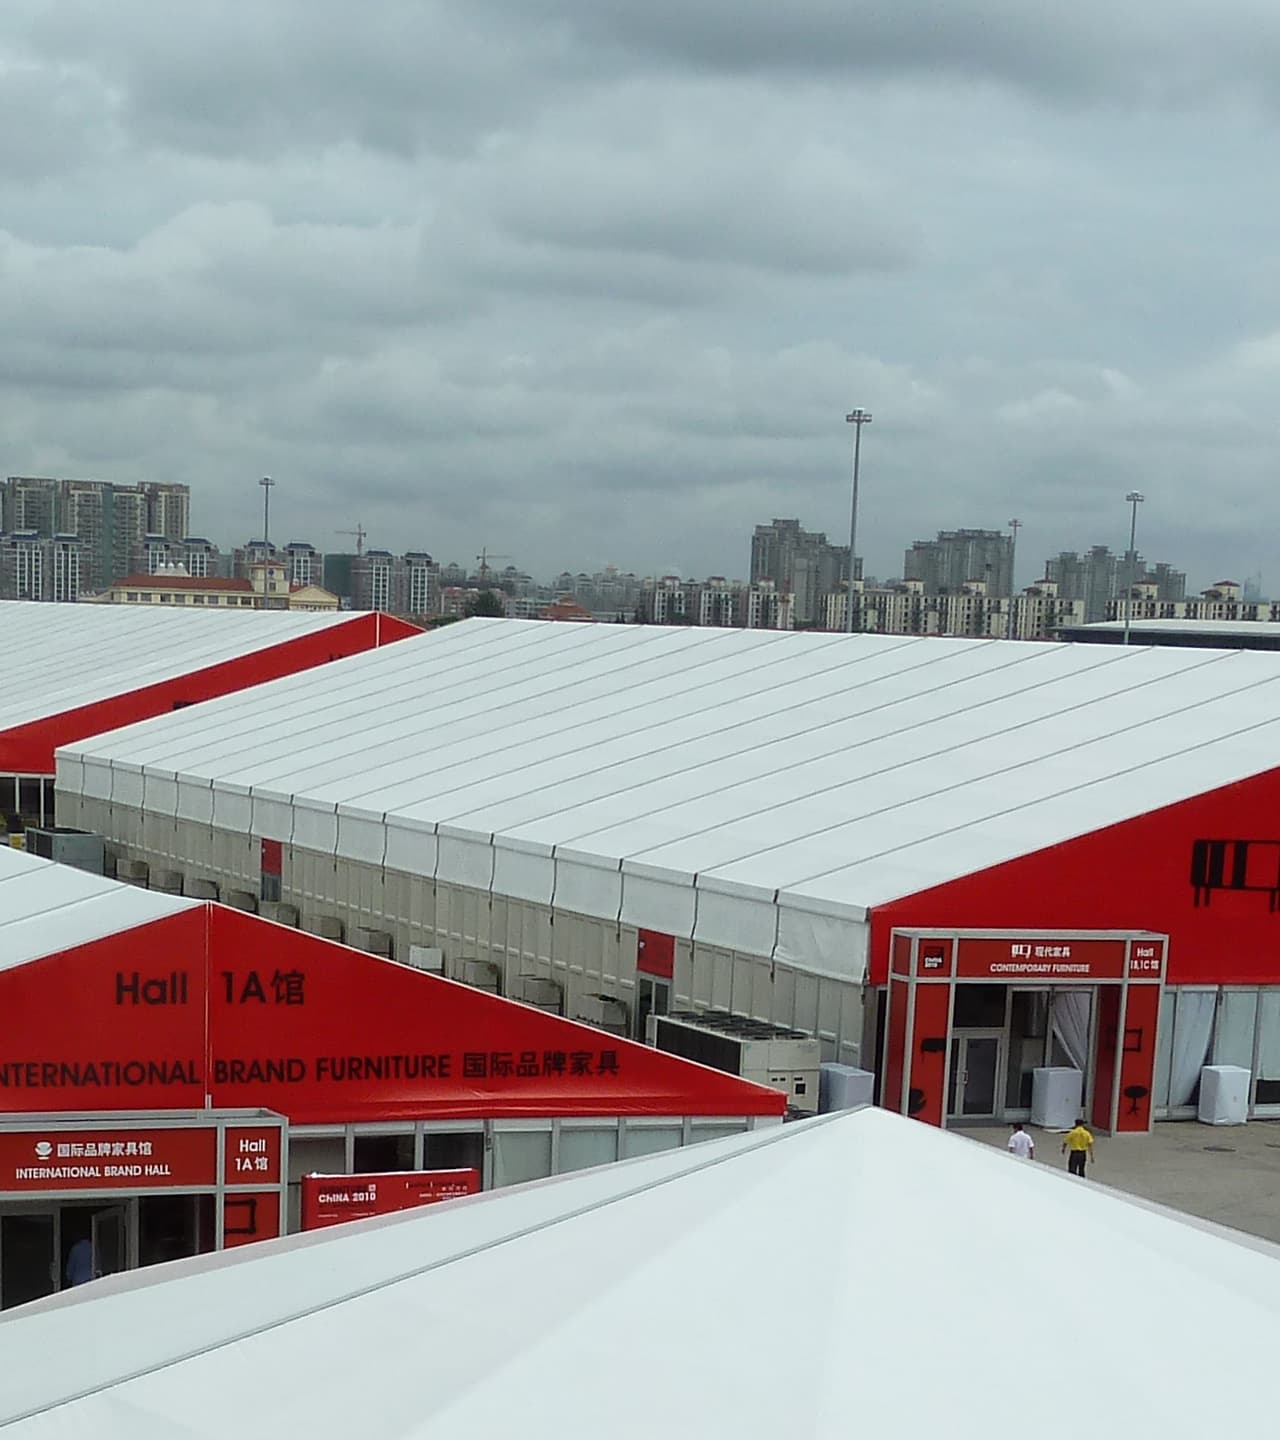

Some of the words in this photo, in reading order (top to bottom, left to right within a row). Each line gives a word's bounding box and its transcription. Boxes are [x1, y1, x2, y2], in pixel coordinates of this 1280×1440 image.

[990, 962, 1050, 973] CONTEMPORARY
[116, 969, 188, 1007] Hall
[213, 1058, 307, 1084] BRAND
[315, 1055, 451, 1081] FURNITURE
[462, 1049, 621, 1080] 国际品牌家具
[57, 1141, 153, 1158] 国际品牌家具馆
[239, 1138, 266, 1153] Hall
[15, 1166, 102, 1180] INTERNATIONAL
[104, 1164, 142, 1178] BRAND
[144, 1163, 171, 1177] HALL
[352, 1191, 377, 1203] 2010
